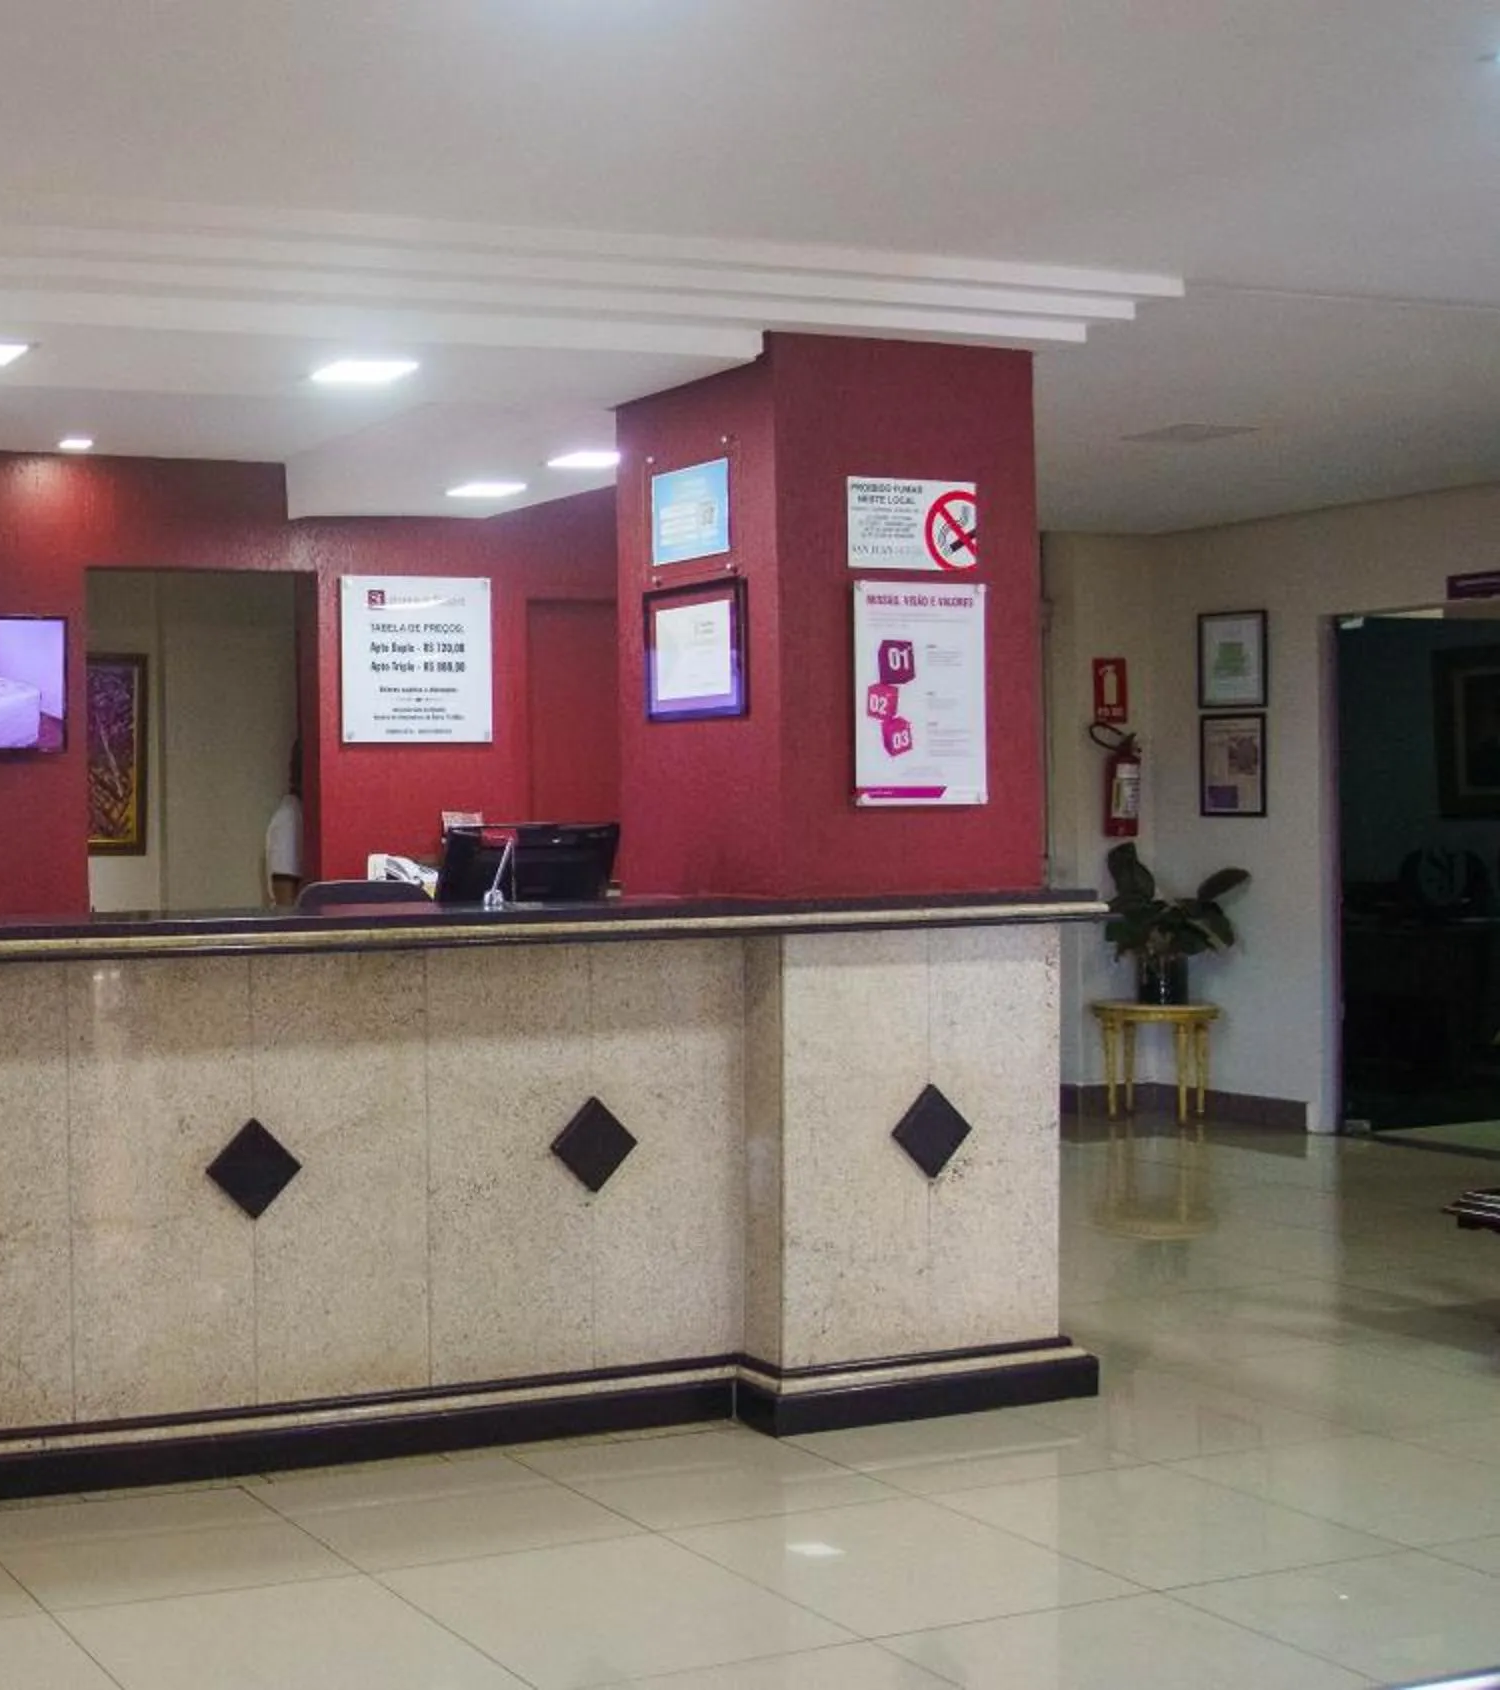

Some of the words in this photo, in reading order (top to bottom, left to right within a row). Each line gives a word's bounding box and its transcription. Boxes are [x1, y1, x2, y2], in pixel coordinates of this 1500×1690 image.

[888, 495, 916, 505] LOCAL
[371, 623, 406, 633] TABELA
[407, 623, 421, 633] DE
[888, 647, 909, 670] 01
[870, 693, 887, 715] 02
[893, 730, 909, 749] 03
